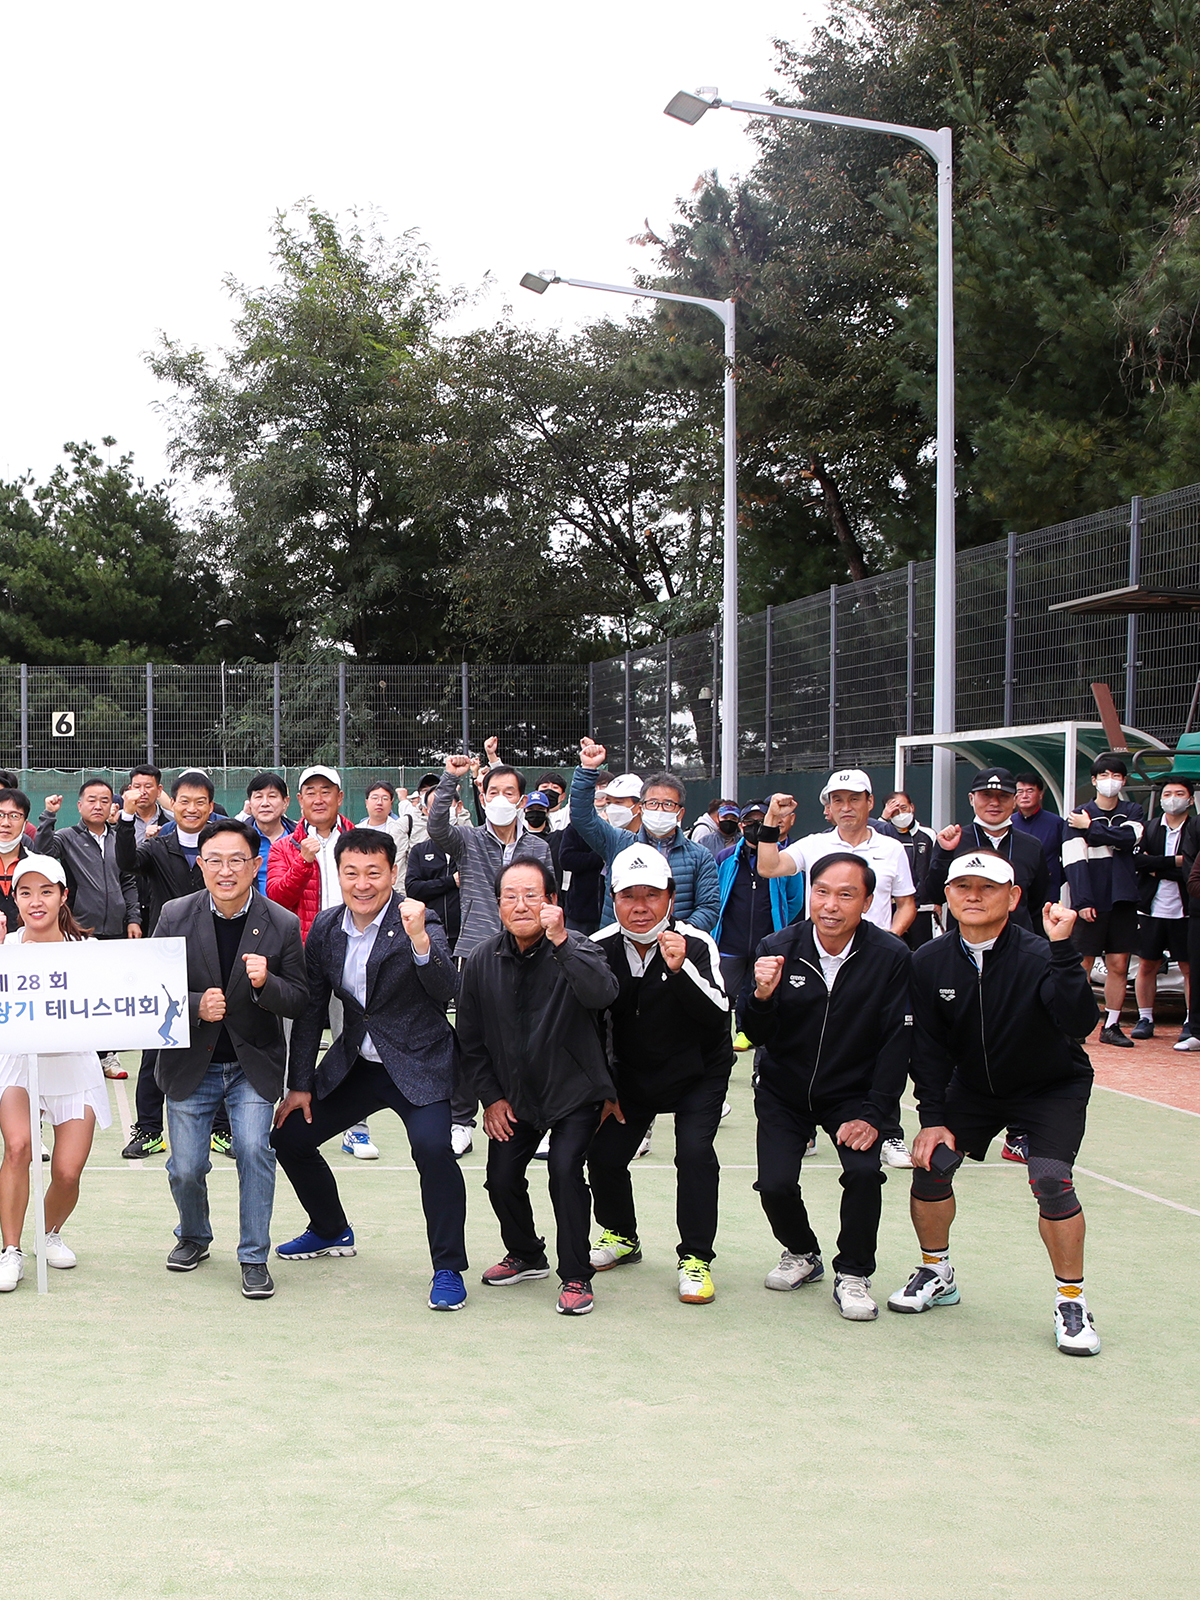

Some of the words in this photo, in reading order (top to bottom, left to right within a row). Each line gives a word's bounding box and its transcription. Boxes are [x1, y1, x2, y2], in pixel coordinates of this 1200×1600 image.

[55, 713, 73, 735] 6
[16, 973, 42, 991] 28
[49, 971, 69, 991] 회
[45, 995, 160, 1020] 테니스대회
